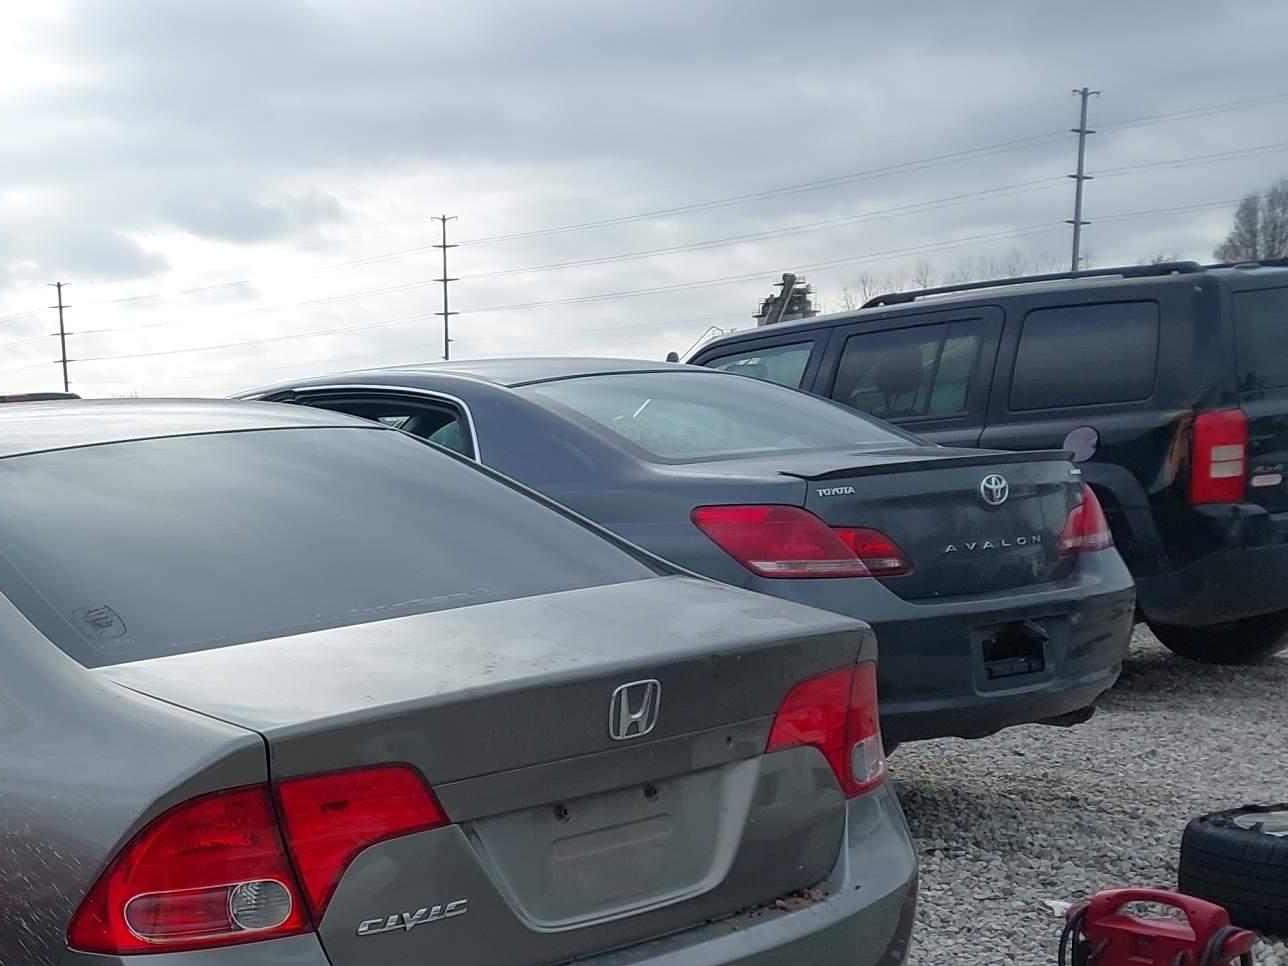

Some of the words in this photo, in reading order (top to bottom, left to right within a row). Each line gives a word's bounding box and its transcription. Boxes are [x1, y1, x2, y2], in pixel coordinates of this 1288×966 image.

[815, 486, 856, 497] TOYOTA
[945, 535, 1042, 553] AVALON
[356, 899, 468, 936] CIVIC
